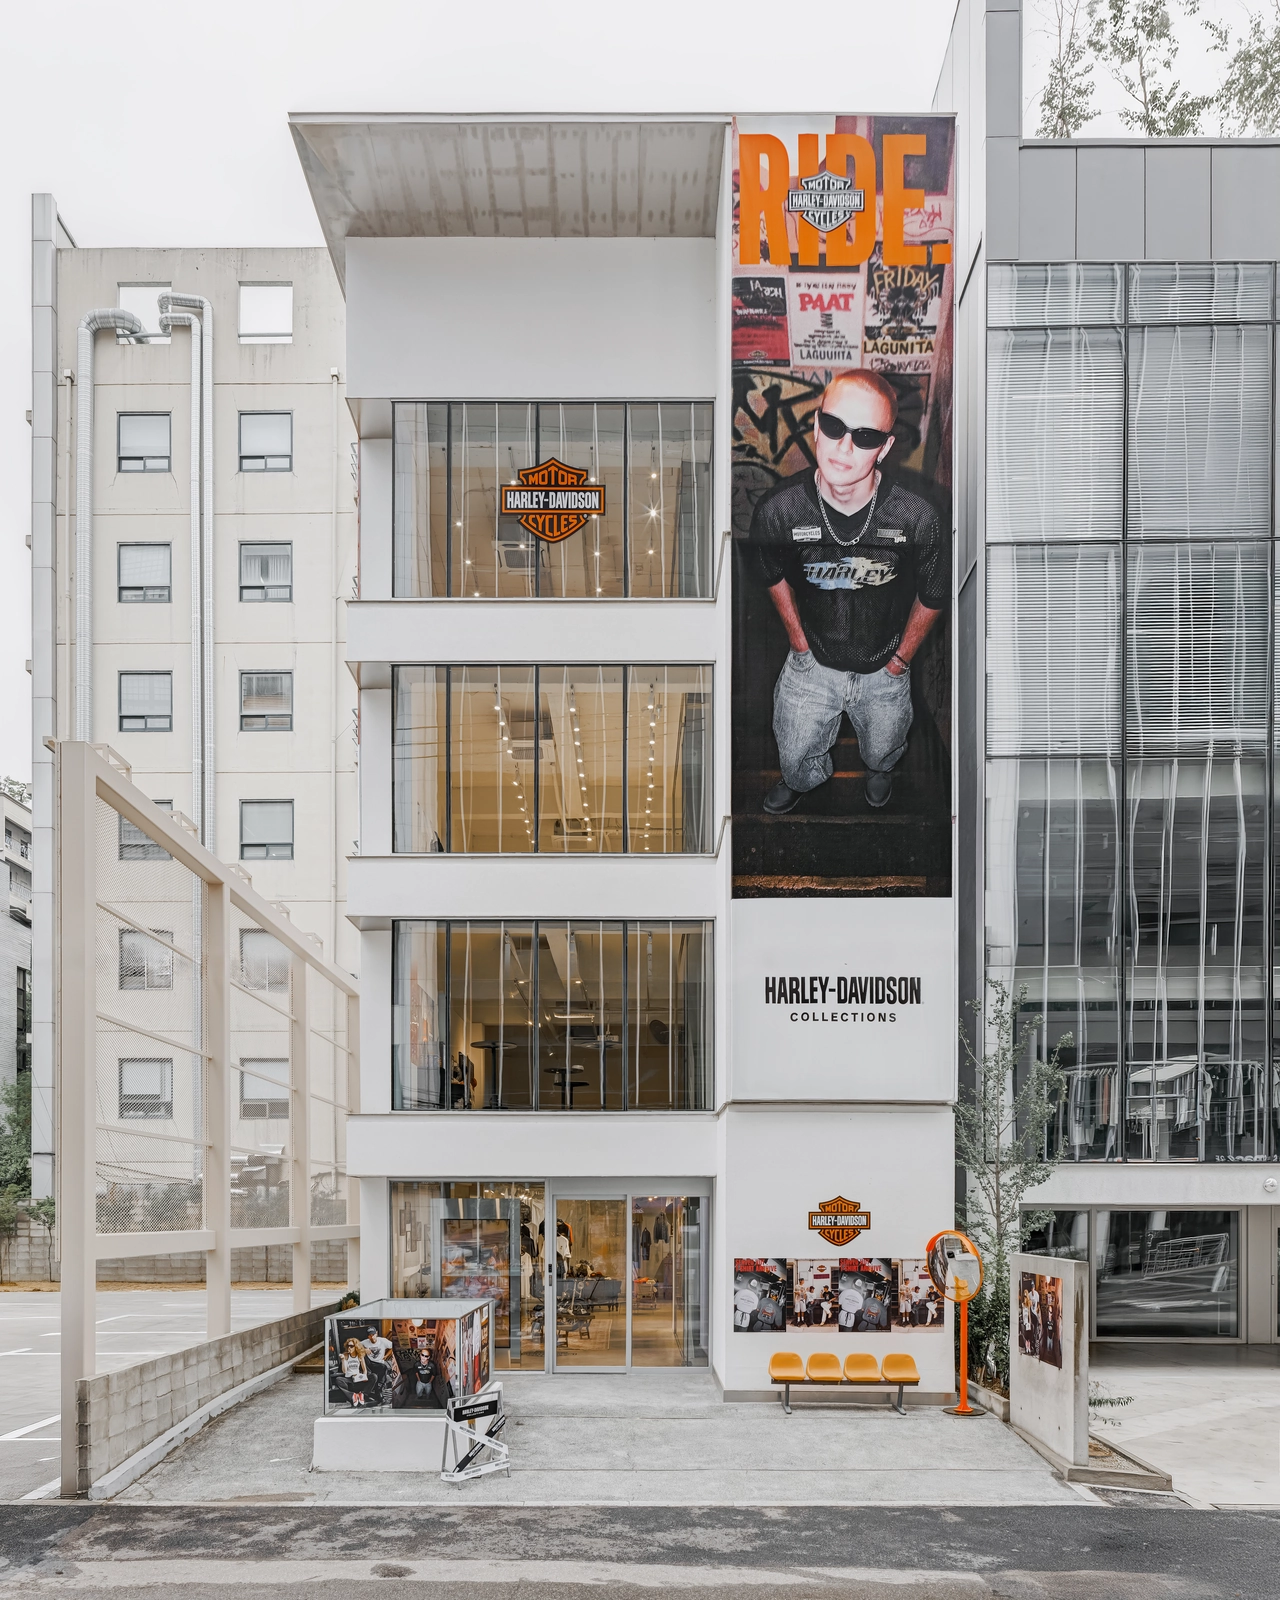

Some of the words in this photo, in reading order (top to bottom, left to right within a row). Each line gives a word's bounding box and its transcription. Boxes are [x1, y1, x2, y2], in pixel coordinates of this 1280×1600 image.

[792, 193, 861, 208] HARLEY-DAVIDSON
[808, 210, 845, 228] CYCLES
[873, 266, 939, 296] FRIDAY
[798, 293, 855, 312] PAAT
[863, 340, 935, 355] LAGUNITA
[528, 465, 578, 486] MOTOR
[506, 491, 600, 509] HARLEY-DAVIDSON
[528, 514, 578, 537] CYCLES
[807, 564, 892, 582] HARLEY
[765, 976, 922, 1005] HARLEY-DAVIDSON
[789, 1012, 897, 1023] COLLECTIONS
[825, 1201, 855, 1213] MOTOR
[812, 1215, 867, 1226] HARLEY-DAVIDSON
[824, 1229, 855, 1243] CYCLES
